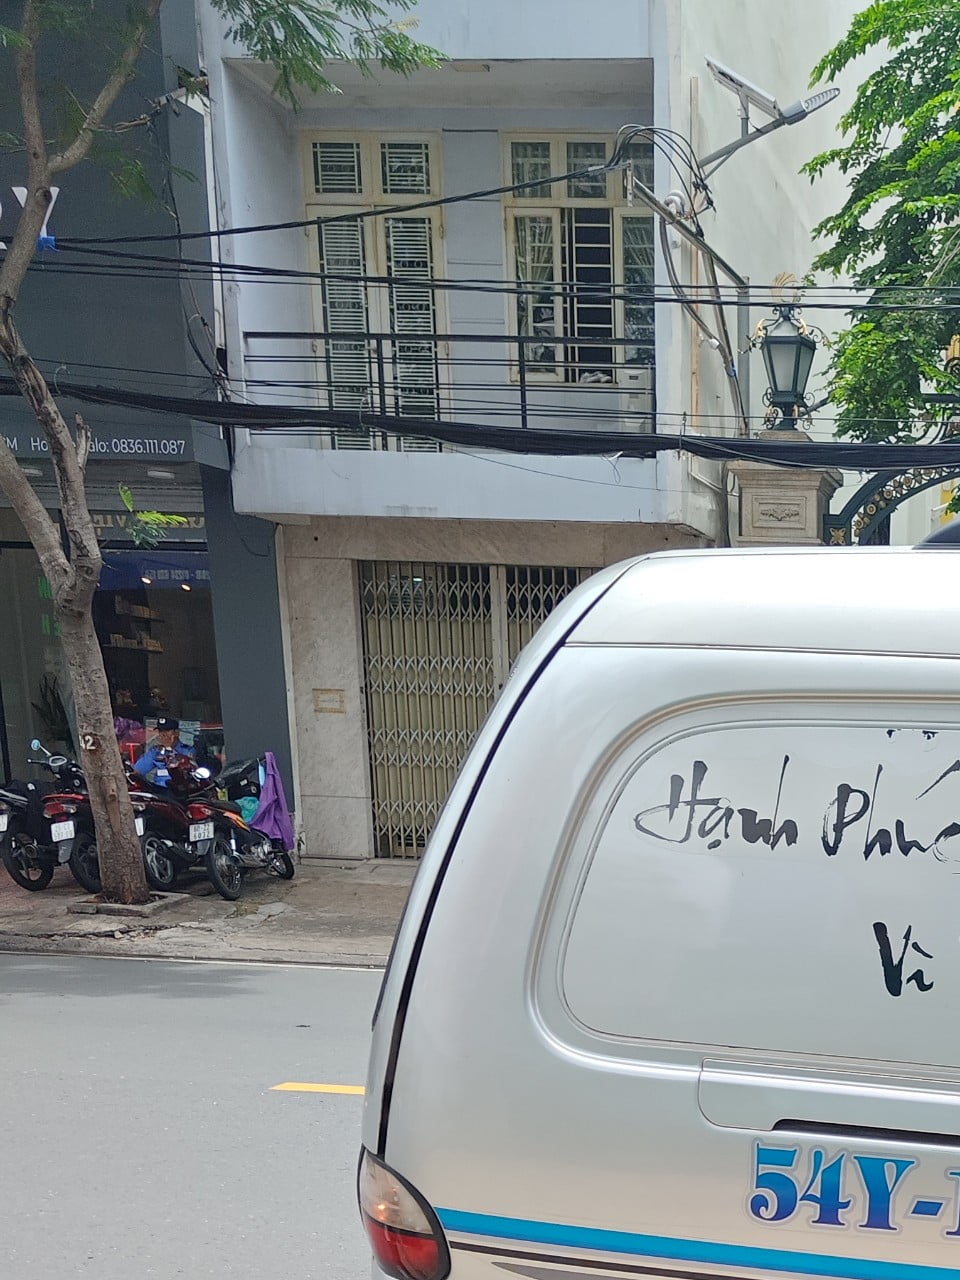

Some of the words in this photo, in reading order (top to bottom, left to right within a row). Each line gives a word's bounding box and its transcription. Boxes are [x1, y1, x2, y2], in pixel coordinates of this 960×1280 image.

[86, 437, 109, 453] alo:
[112, 438, 186, 454] 0836.111.087
[634, 754, 799, 851] Hạnh
[872, 922, 934, 997] Vì
